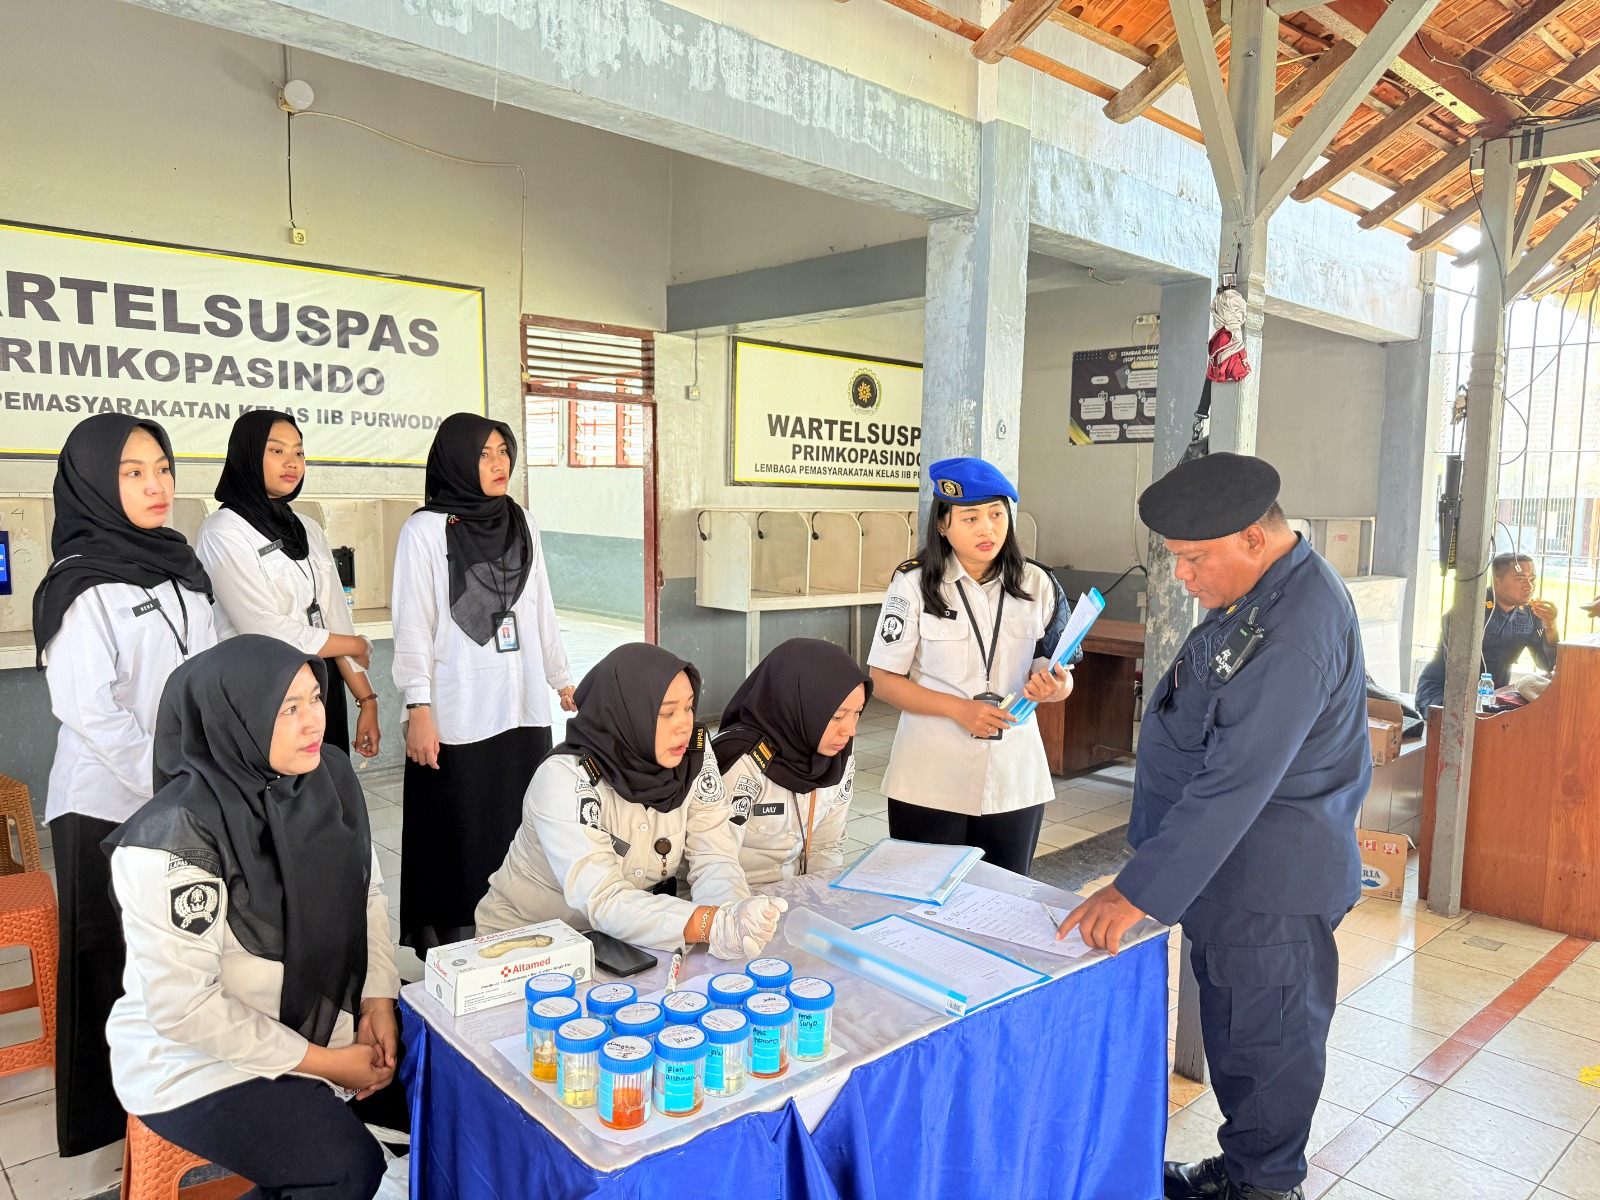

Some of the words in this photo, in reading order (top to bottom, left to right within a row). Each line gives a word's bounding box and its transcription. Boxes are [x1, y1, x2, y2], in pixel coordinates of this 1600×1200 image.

[0, 271, 440, 357] RTELSUSPAS
[0, 391, 230, 420] EMASYARAKATAN
[317, 408, 344, 425] IIB
[754, 463, 797, 474] LEMBAGA
[799, 465, 874, 478] PEMASYARAKATAN
[875, 468, 899, 479] KELAS
[901, 470, 911, 479] IIB
[752, 750, 766, 769] IMPAS
[762, 806, 777, 814] LAILY
[512, 956, 551, 975] Altamed
